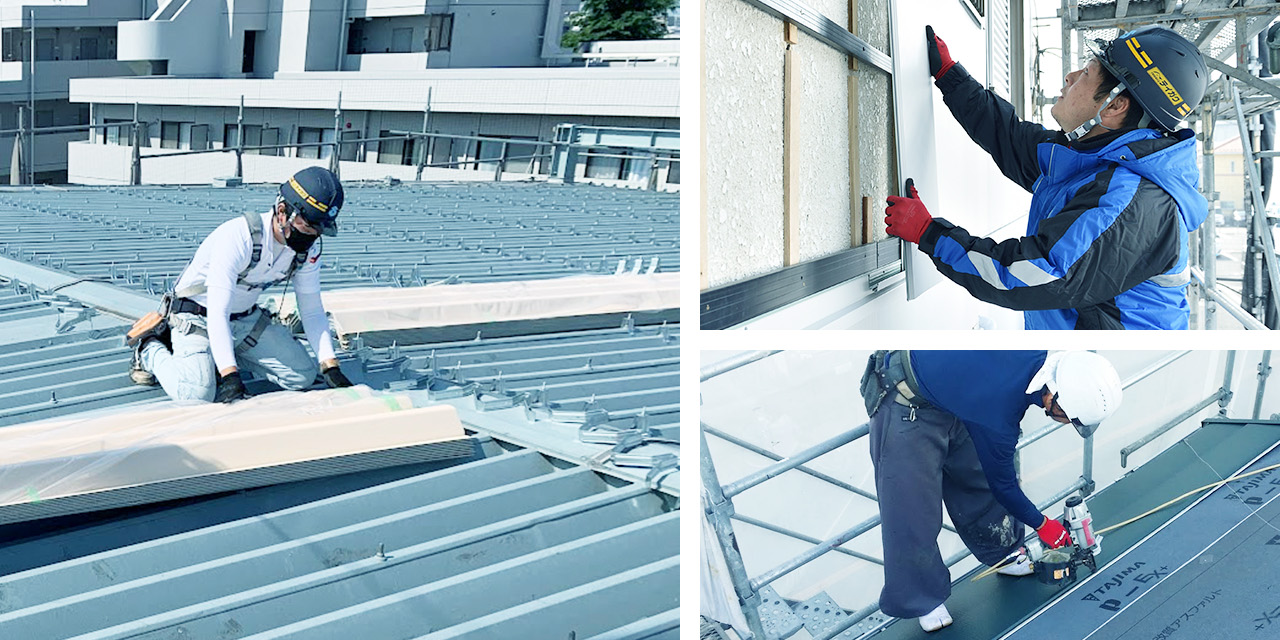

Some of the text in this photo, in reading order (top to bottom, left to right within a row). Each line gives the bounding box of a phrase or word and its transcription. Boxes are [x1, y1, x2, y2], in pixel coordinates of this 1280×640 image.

[1159, 80, 1180, 103] テイガク
[1093, 560, 1146, 596] TAJIMA
